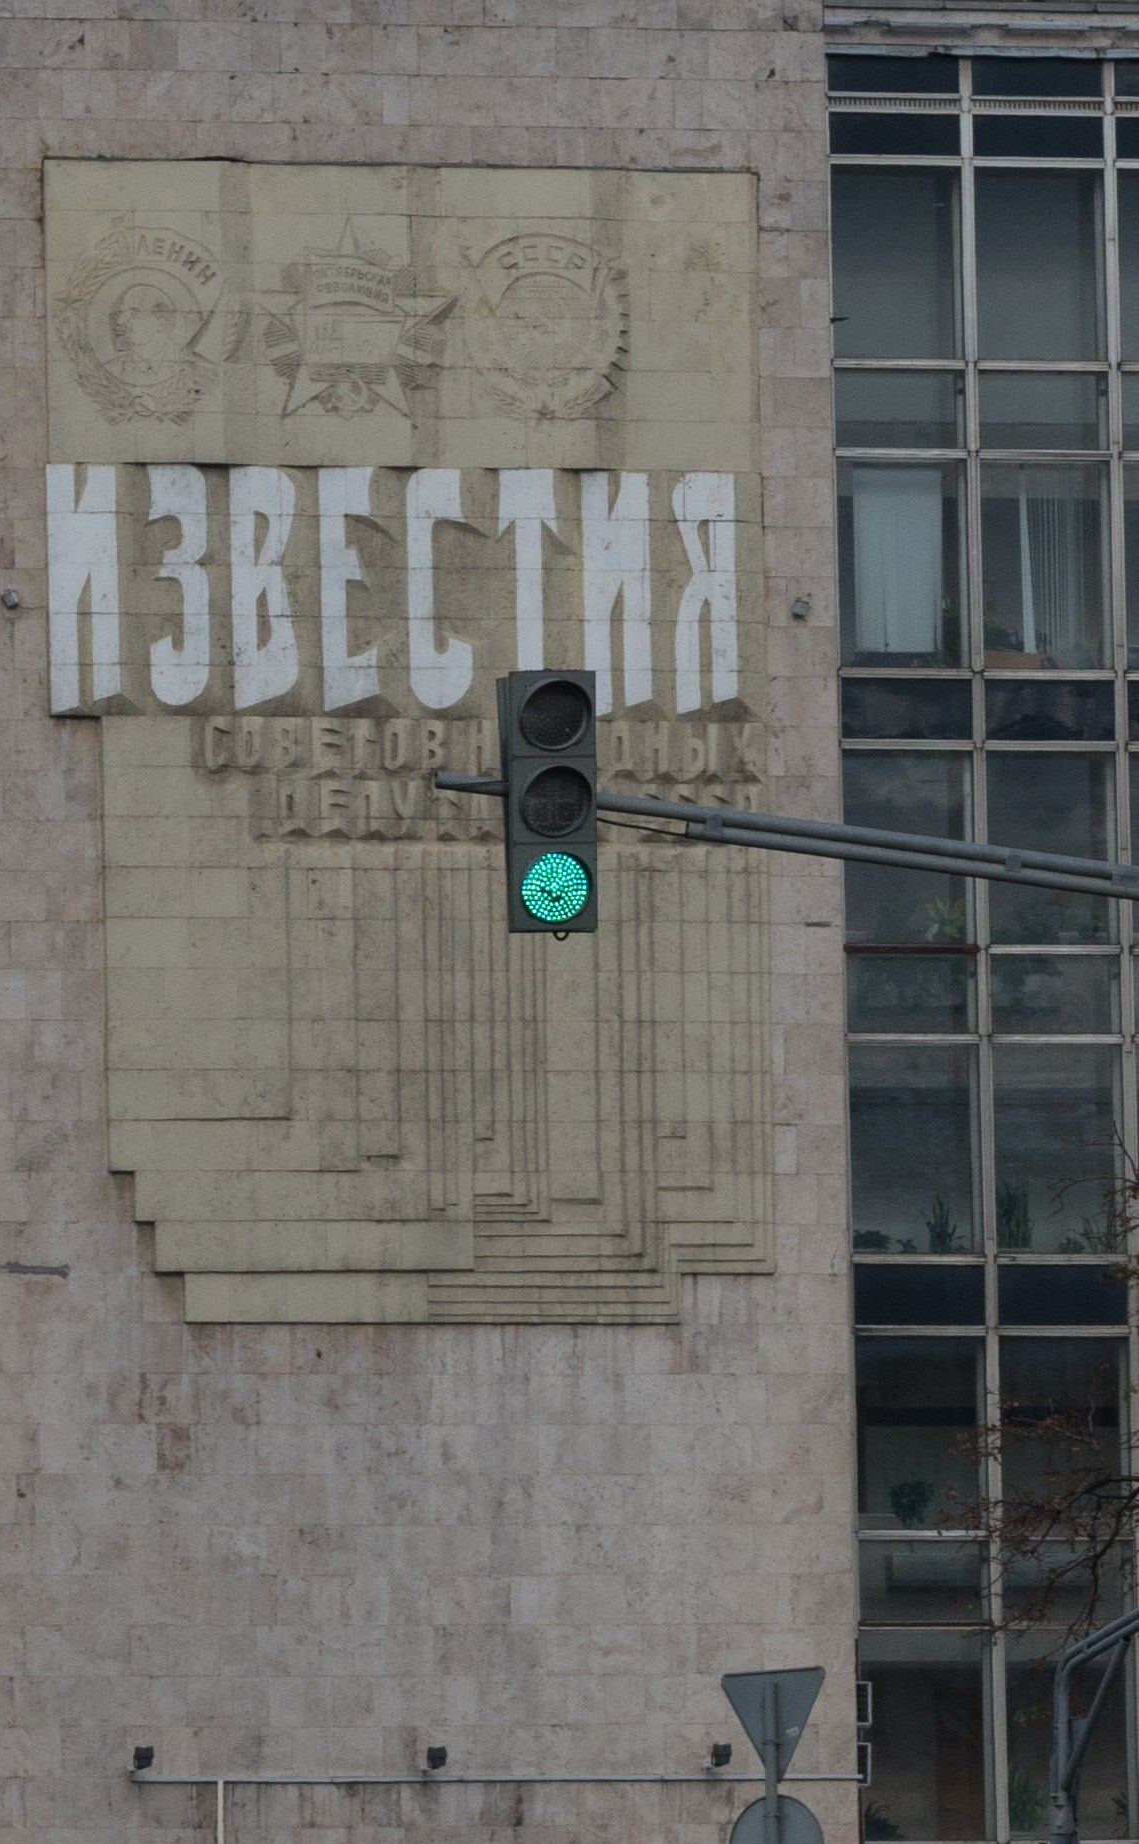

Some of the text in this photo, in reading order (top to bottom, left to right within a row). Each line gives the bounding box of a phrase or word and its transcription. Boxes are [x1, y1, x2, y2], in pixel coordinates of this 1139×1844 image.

[136, 233, 217, 286] ЛЕНИН
[497, 243, 589, 271] СССР
[46, 463, 740, 716] ИЗВЕСТИЯ
[204, 716, 445, 771] СОВЕТОВ
